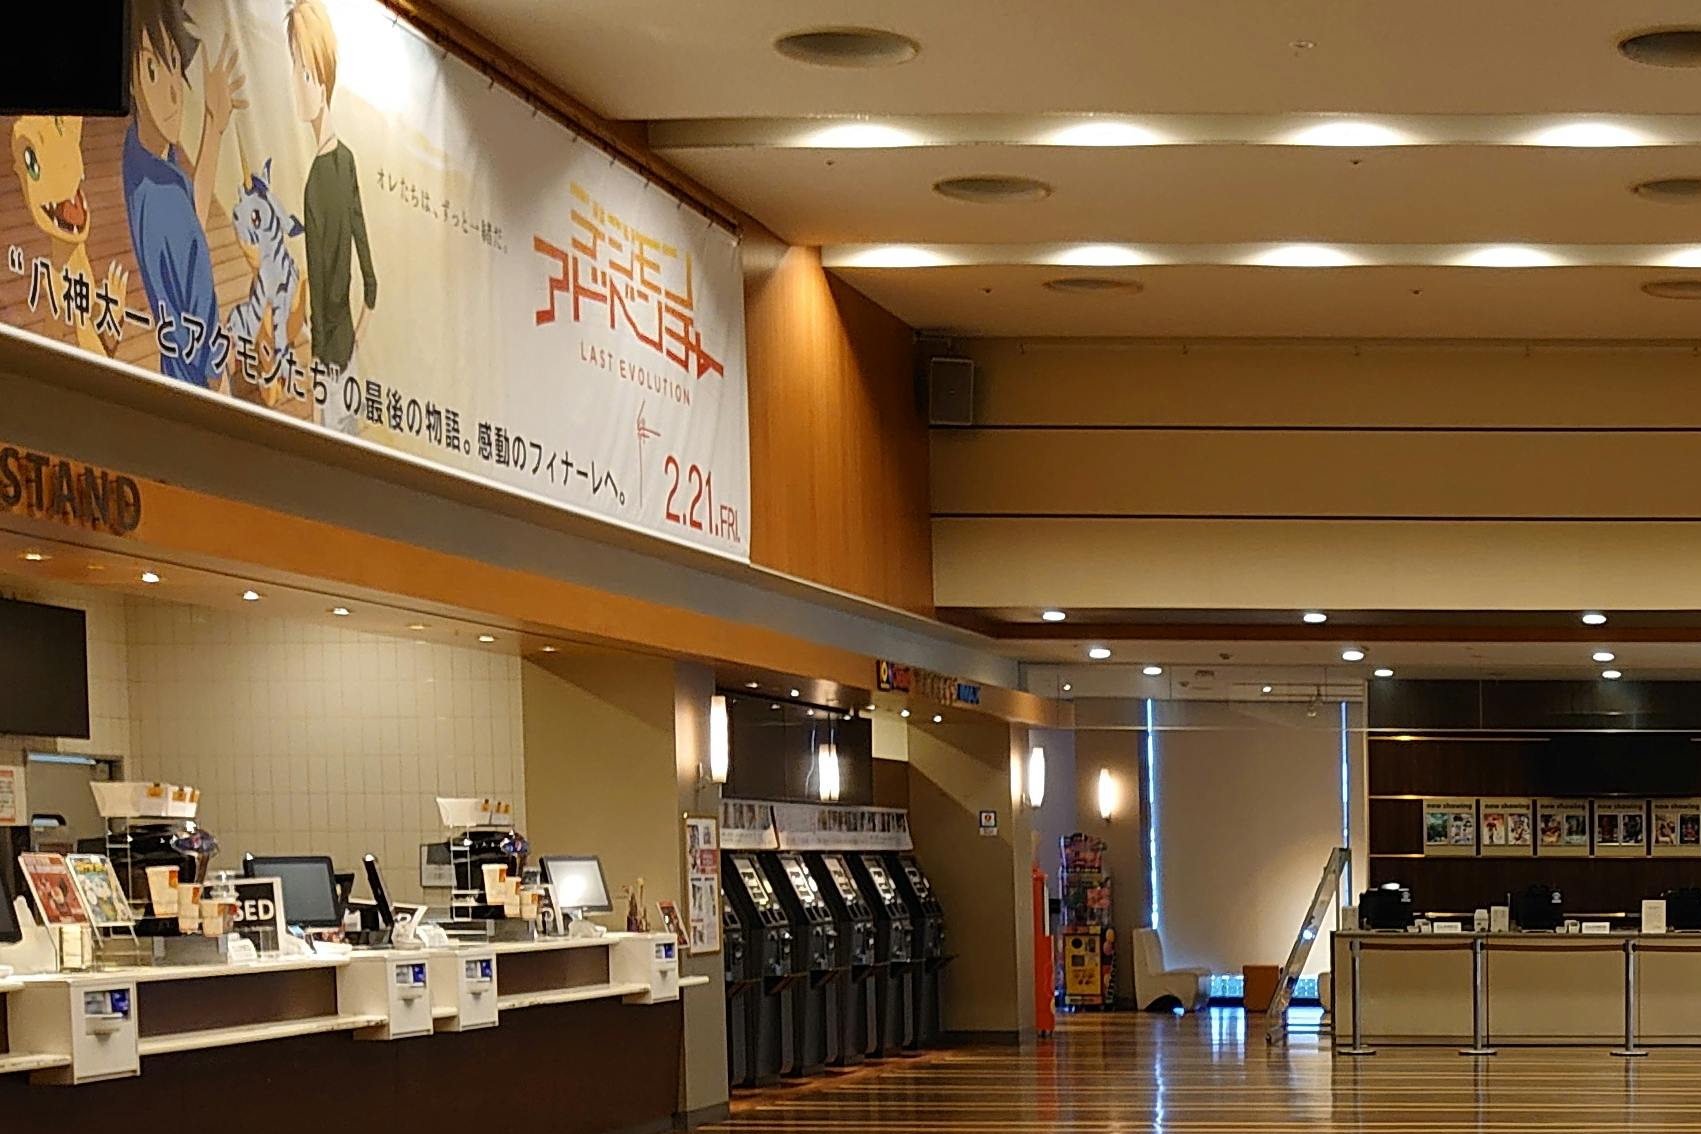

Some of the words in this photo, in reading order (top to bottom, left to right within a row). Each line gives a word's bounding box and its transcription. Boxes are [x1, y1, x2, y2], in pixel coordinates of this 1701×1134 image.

[580, 341, 614, 372] LAST
[619, 358, 692, 406] EVOLUTION
[0, 447, 142, 532] STAND
